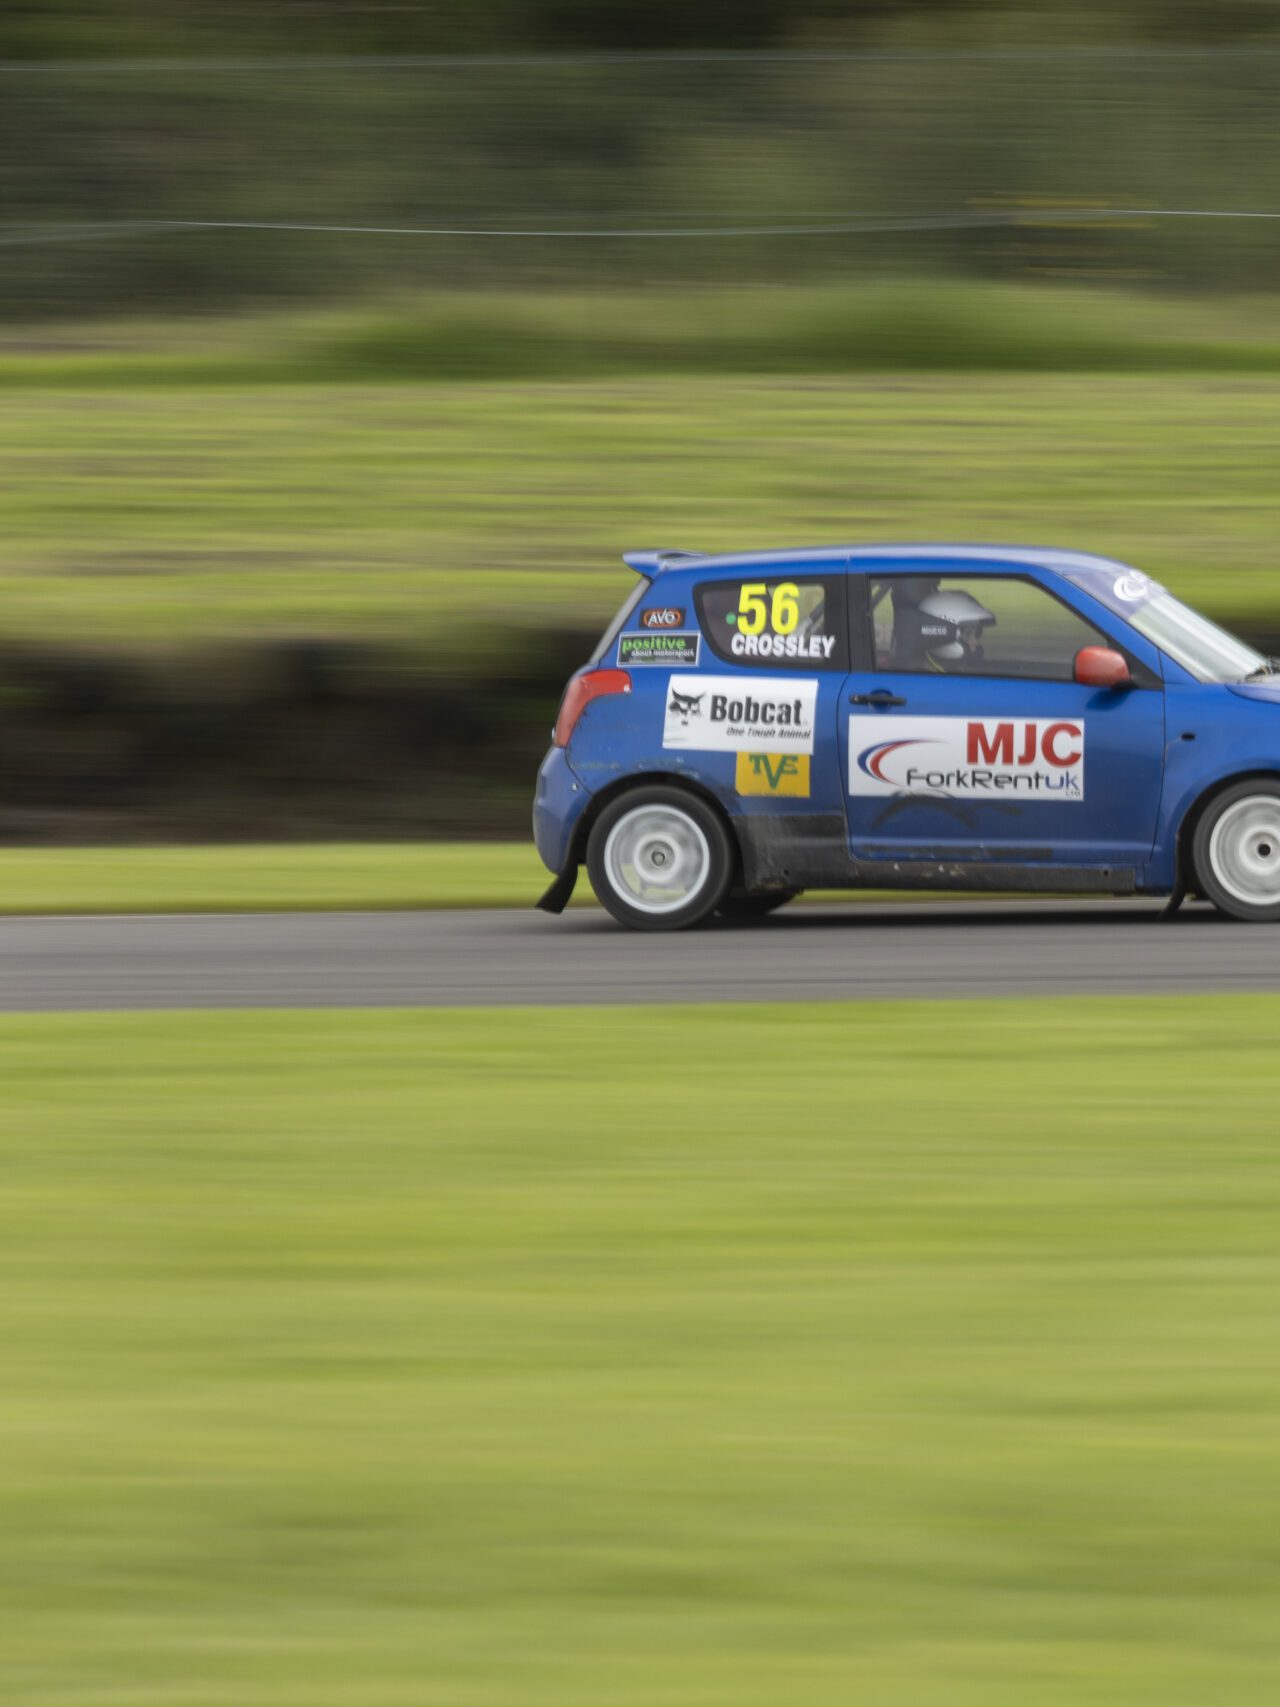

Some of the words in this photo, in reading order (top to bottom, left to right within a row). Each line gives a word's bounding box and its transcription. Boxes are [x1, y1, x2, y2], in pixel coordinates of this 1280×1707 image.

[647, 608, 677, 628] AVO
[737, 583, 800, 635] 56
[622, 635, 686, 654] positive
[731, 633, 836, 658] CROSSLEY
[710, 694, 803, 725] Bobcat
[726, 726, 745, 737] One
[778, 728, 811, 740] Animal
[966, 722, 1081, 768] MJC
[749, 753, 799, 789] TVE
